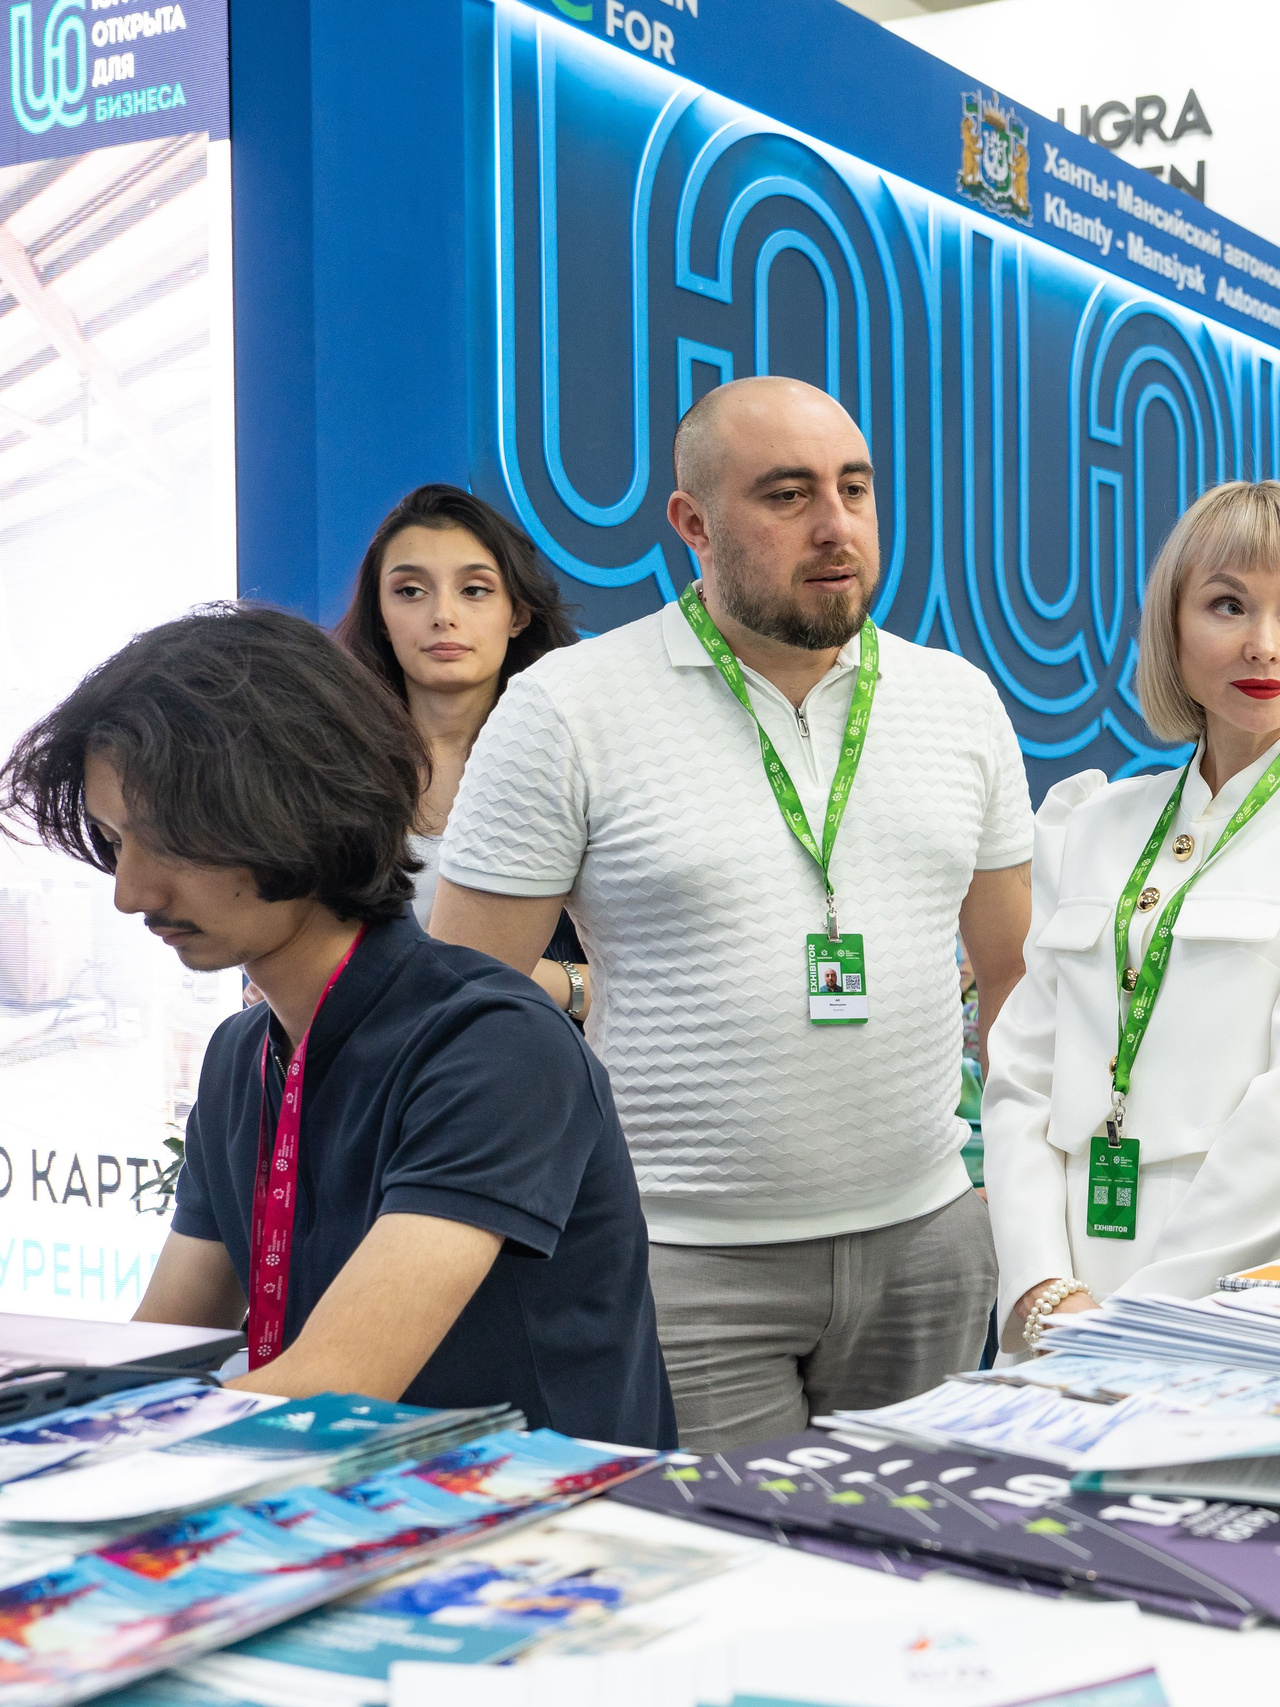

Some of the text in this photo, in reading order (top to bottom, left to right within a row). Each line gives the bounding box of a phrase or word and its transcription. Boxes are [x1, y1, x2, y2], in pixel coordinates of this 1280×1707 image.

[91, 4, 187, 48] ОТКРЫТА
[606, 0, 676, 66] FOR
[92, 52, 135, 88] ДЛЯ
[94, 82, 187, 123] БИЗНЕСА
[1044, 191, 1113, 257] Khanty
[1127, 230, 1206, 295] Mansiysk
[808, 944, 818, 993] EXHIBITOR
[1094, 1223, 1129, 1234] EXHIBITOR
[0, 1237, 157, 1301] УРЕНИ
